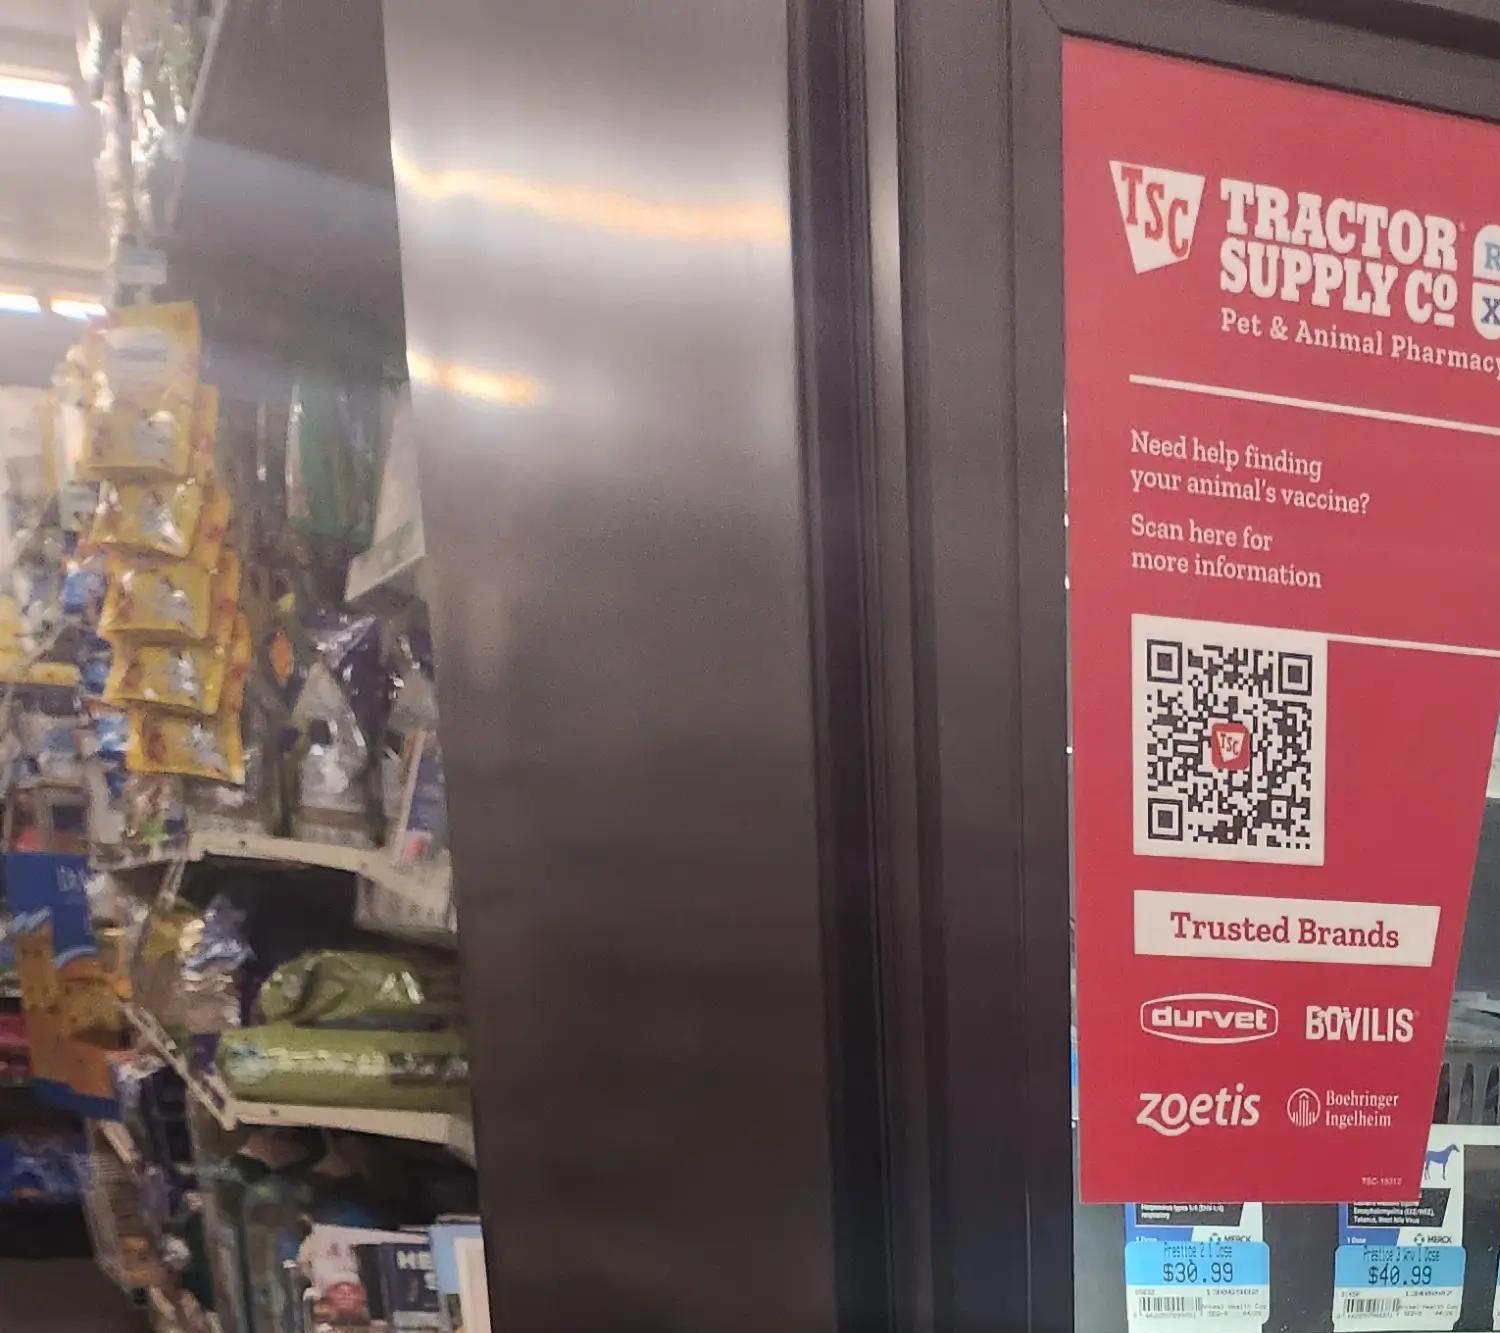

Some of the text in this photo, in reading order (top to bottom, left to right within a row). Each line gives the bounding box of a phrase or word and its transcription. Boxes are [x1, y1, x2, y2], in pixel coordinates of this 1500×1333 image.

[1121, 168, 1189, 258] TSC
[1220, 178, 1457, 272] TRACTOR
[1220, 239, 1392, 318] SUPPLY
[1221, 307, 1261, 337] Pet
[1270, 317, 1288, 342] &
[1295, 321, 1383, 356] Animal
[1130, 430, 1322, 481] Need help finding
[1130, 471, 1370, 515] your animal's vaccine?
[1131, 514, 1273, 551] Scan here for
[1131, 552, 1321, 589] more information
[1220, 733, 1241, 757] TSC
[1170, 911, 1400, 949] Trusted Brands
[1151, 1005, 1414, 1043] durvet BOVILIS
[1136, 1084, 1260, 1136] zoetis
[1325, 1089, 1399, 1110] Boehringer
[1325, 1109, 1392, 1128] Ingelheim
[1163, 1262, 1233, 1284] $30.99
[1368, 1264, 1432, 1286] $40.99
